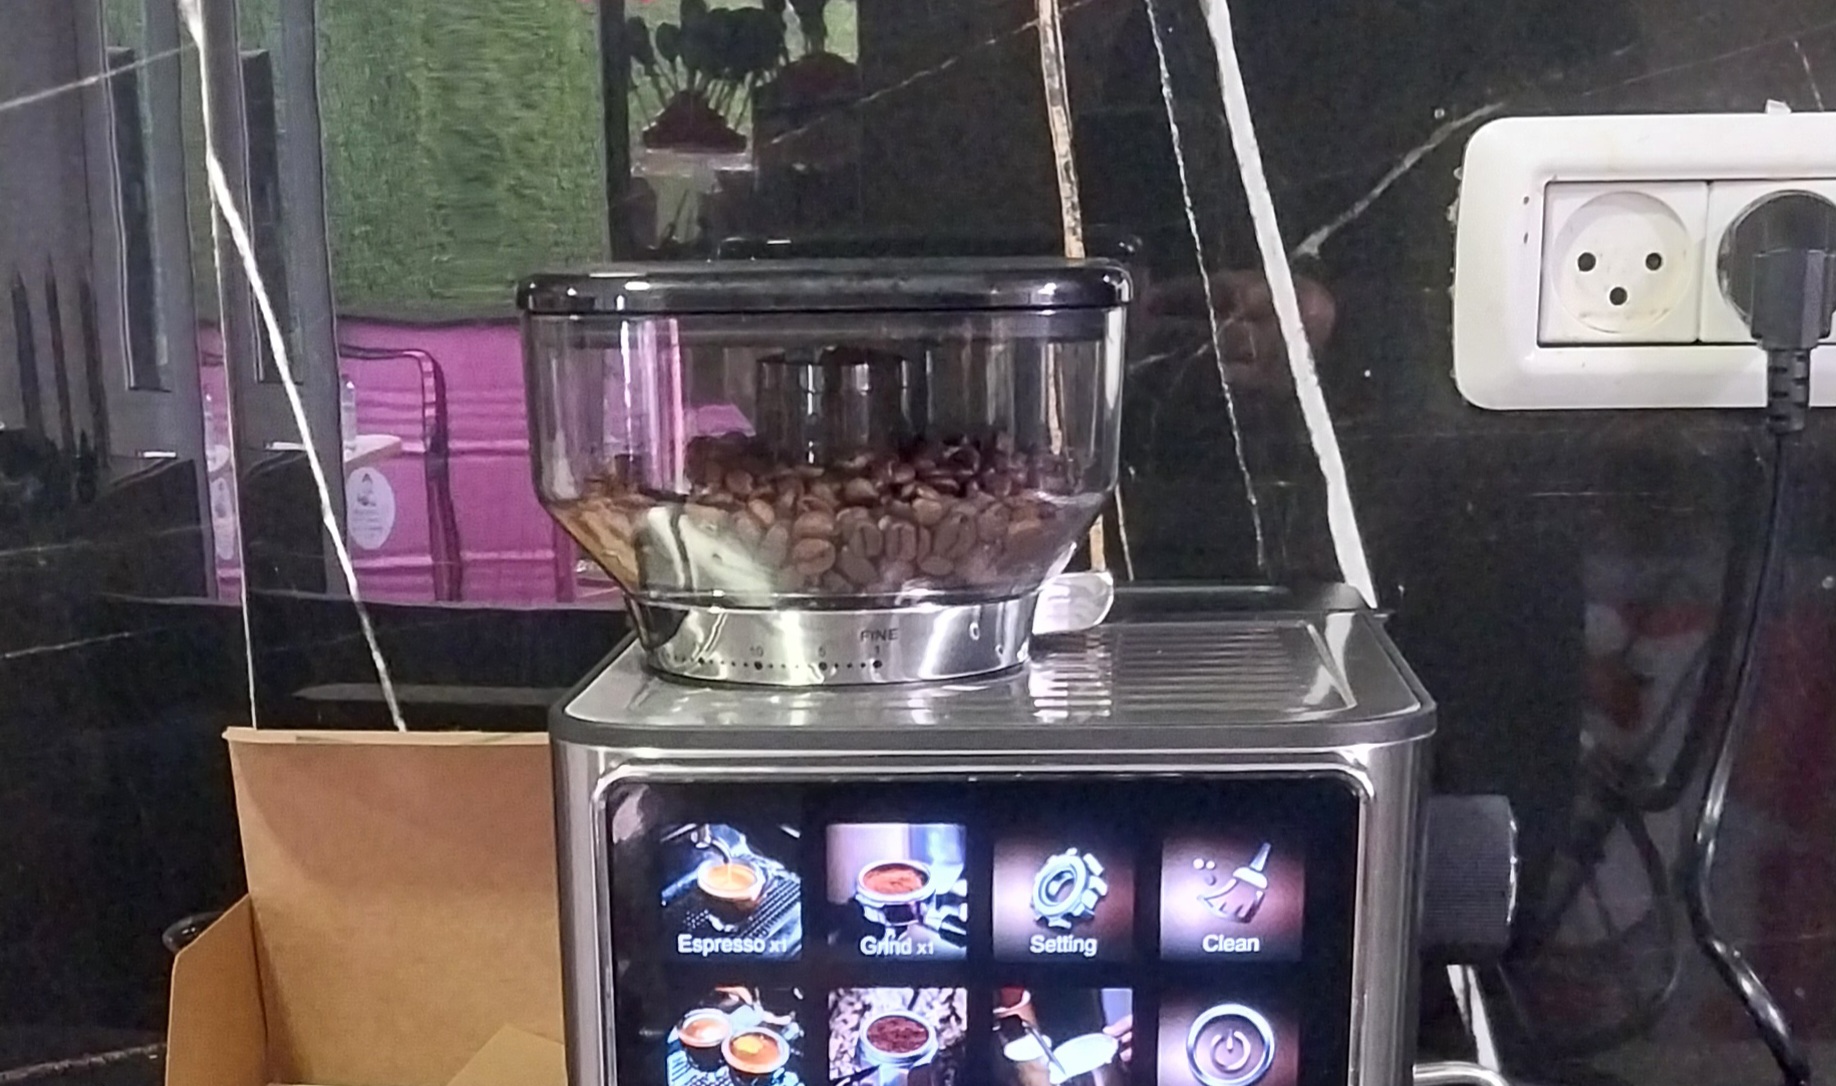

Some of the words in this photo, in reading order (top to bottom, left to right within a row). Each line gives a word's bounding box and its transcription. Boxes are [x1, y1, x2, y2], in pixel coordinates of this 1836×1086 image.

[860, 629, 898, 643] FINE
[749, 645, 764, 657] 10
[677, 933, 766, 957] Espresso
[769, 938, 788, 952] x1
[859, 935, 913, 955] Grind
[916, 942, 935, 955] x1
[1029, 934, 1098, 957] Setting
[1202, 934, 1260, 953] Clean
